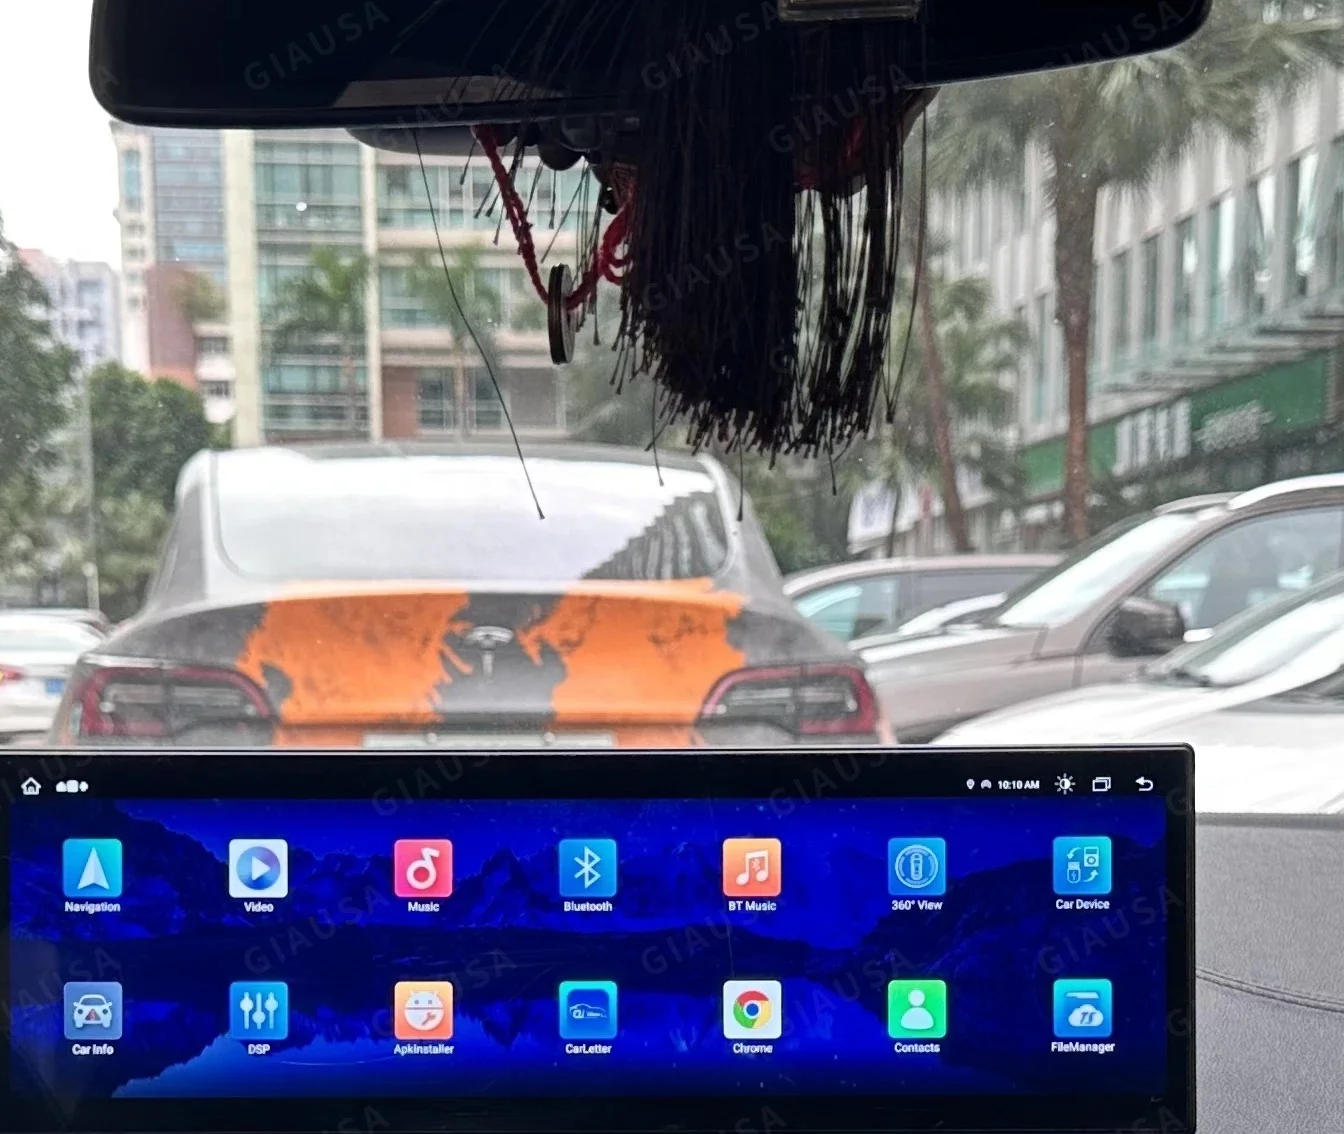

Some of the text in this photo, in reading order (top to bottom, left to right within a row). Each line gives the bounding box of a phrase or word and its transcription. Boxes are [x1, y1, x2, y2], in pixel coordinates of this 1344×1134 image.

[997, 780, 1040, 790] 10:10 AM
[64, 901, 121, 914] Navigation
[243, 901, 274, 913] Video
[407, 901, 440, 912] Music
[563, 901, 613, 912] Bluetooth
[728, 900, 777, 911] BT Music
[917, 900, 943, 911] View
[1055, 899, 1110, 910] Car Device
[71, 1043, 114, 1055] Car Info
[248, 1043, 270, 1055] DSP
[393, 1043, 454, 1056] ApkInstaller
[565, 1043, 612, 1055] CarLetter
[732, 1043, 773, 1054] Chrome
[894, 1042, 940, 1053] Contacts
[1051, 1041, 1115, 1054] FileManager
